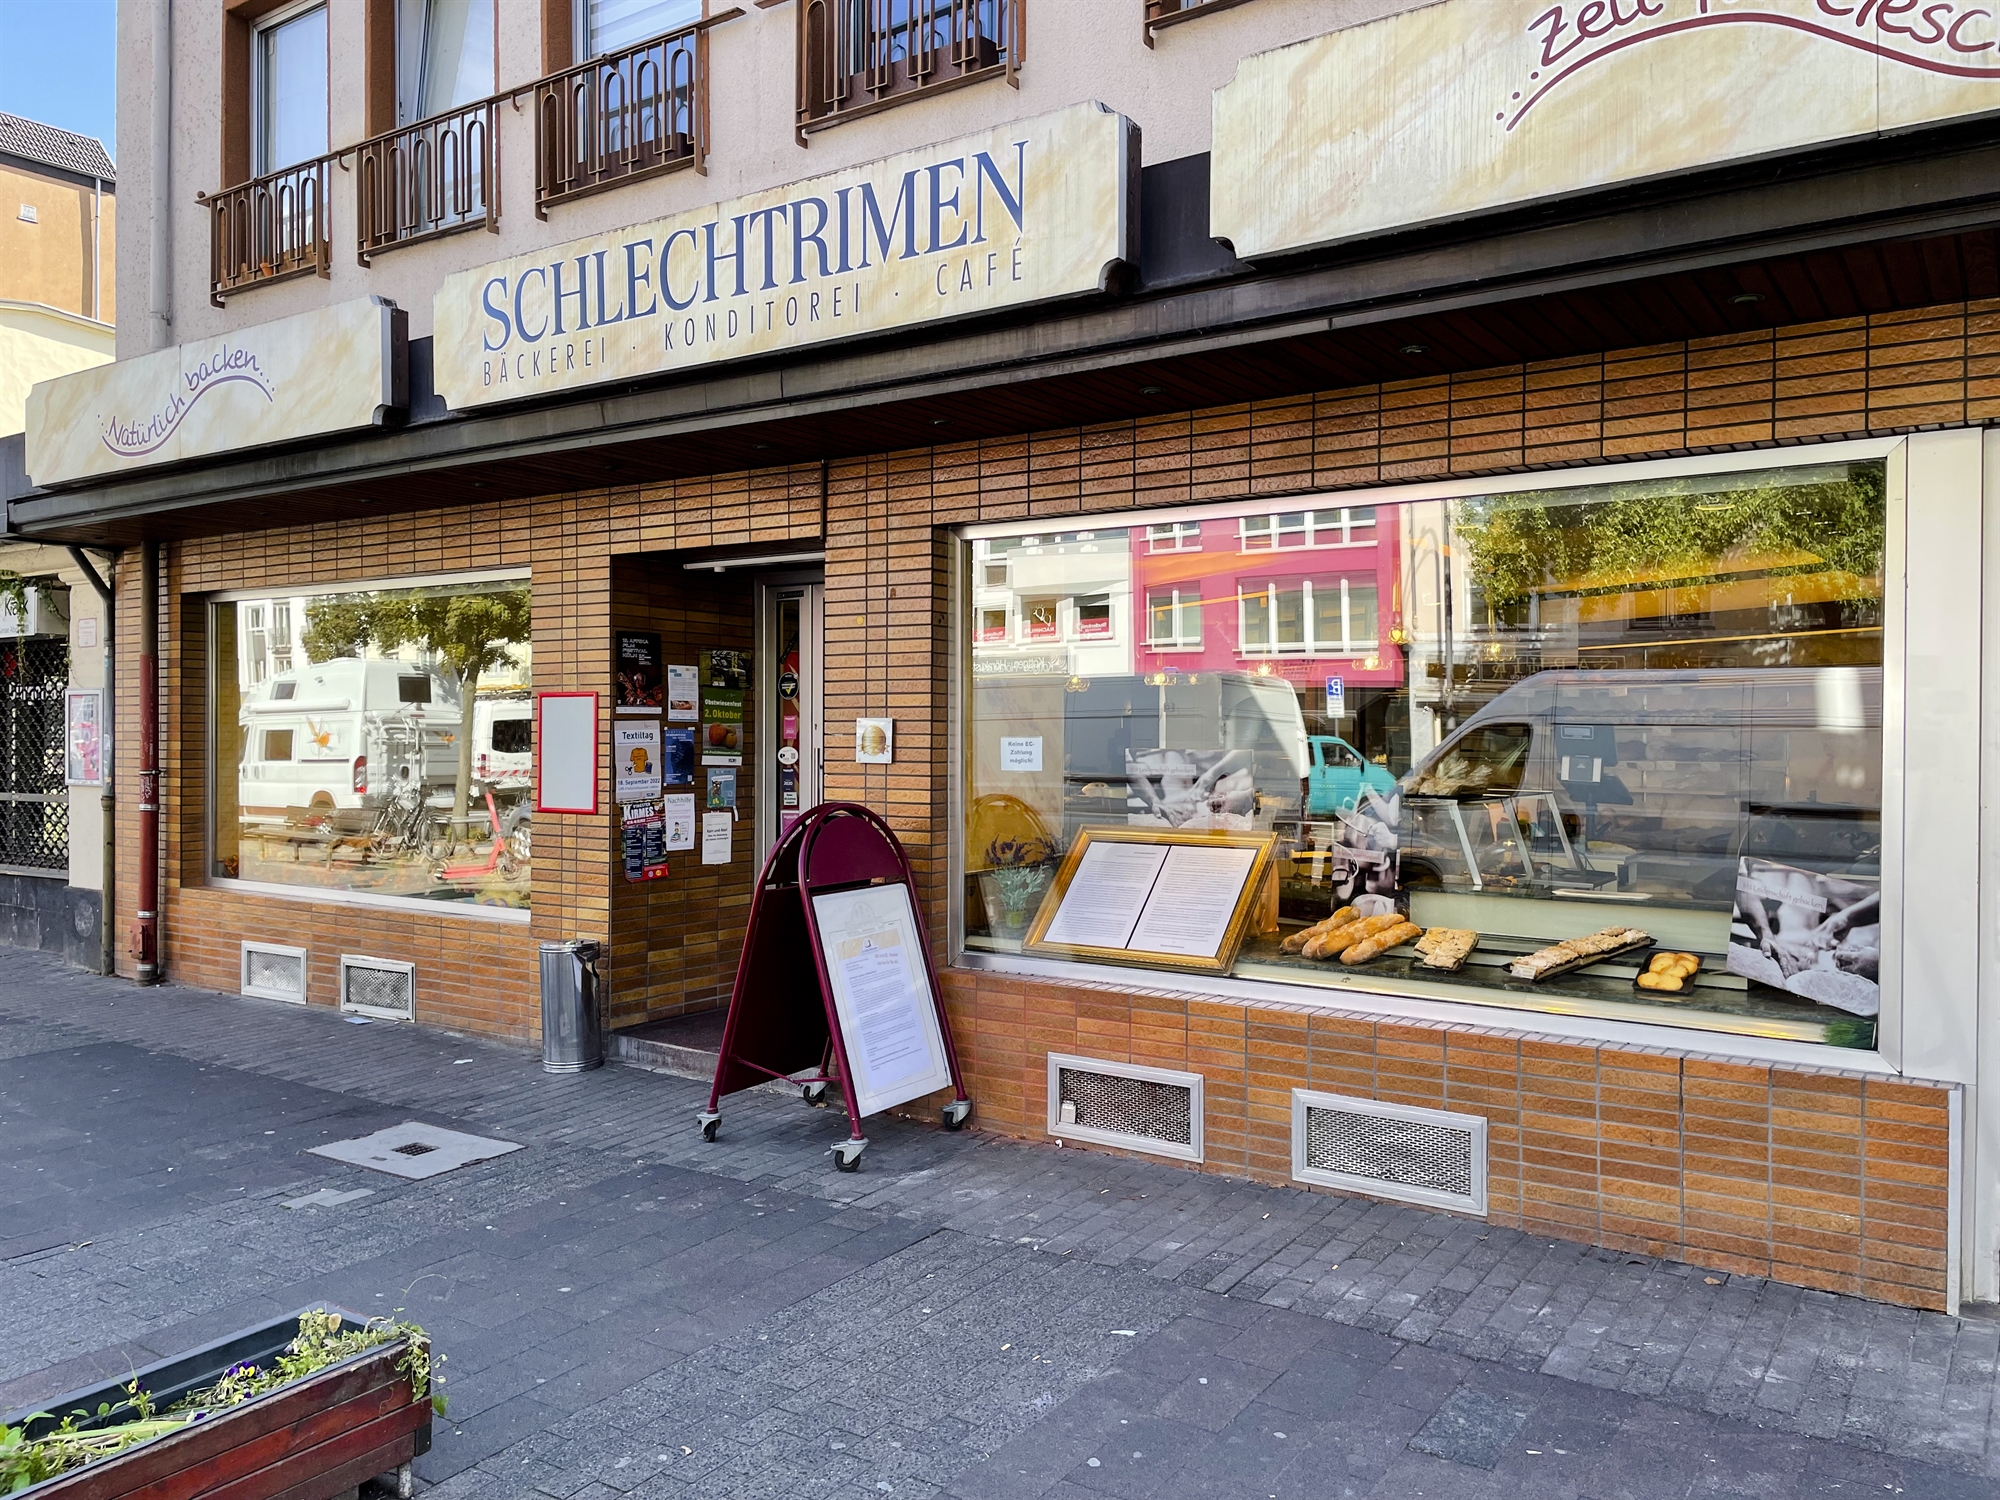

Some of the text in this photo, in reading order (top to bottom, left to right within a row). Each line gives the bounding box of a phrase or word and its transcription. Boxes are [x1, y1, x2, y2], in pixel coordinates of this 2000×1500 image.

[482, 140, 1029, 352] SCHLECHTRIMEN
[484, 237, 1022, 386] BÄCKEREI KONDITOREI CAFÉ
[108, 393, 185, 447] Natürlich
[704, 699, 742, 707] Obstwiesenfest
[704, 709, 742, 719] 2. Oktober
[622, 731, 654, 741] Textiltag
[1009, 757, 1034, 765] möglich!
[667, 796, 692, 804] Nachhilfe
[1753, 885, 1792, 901] Leidenschaft
